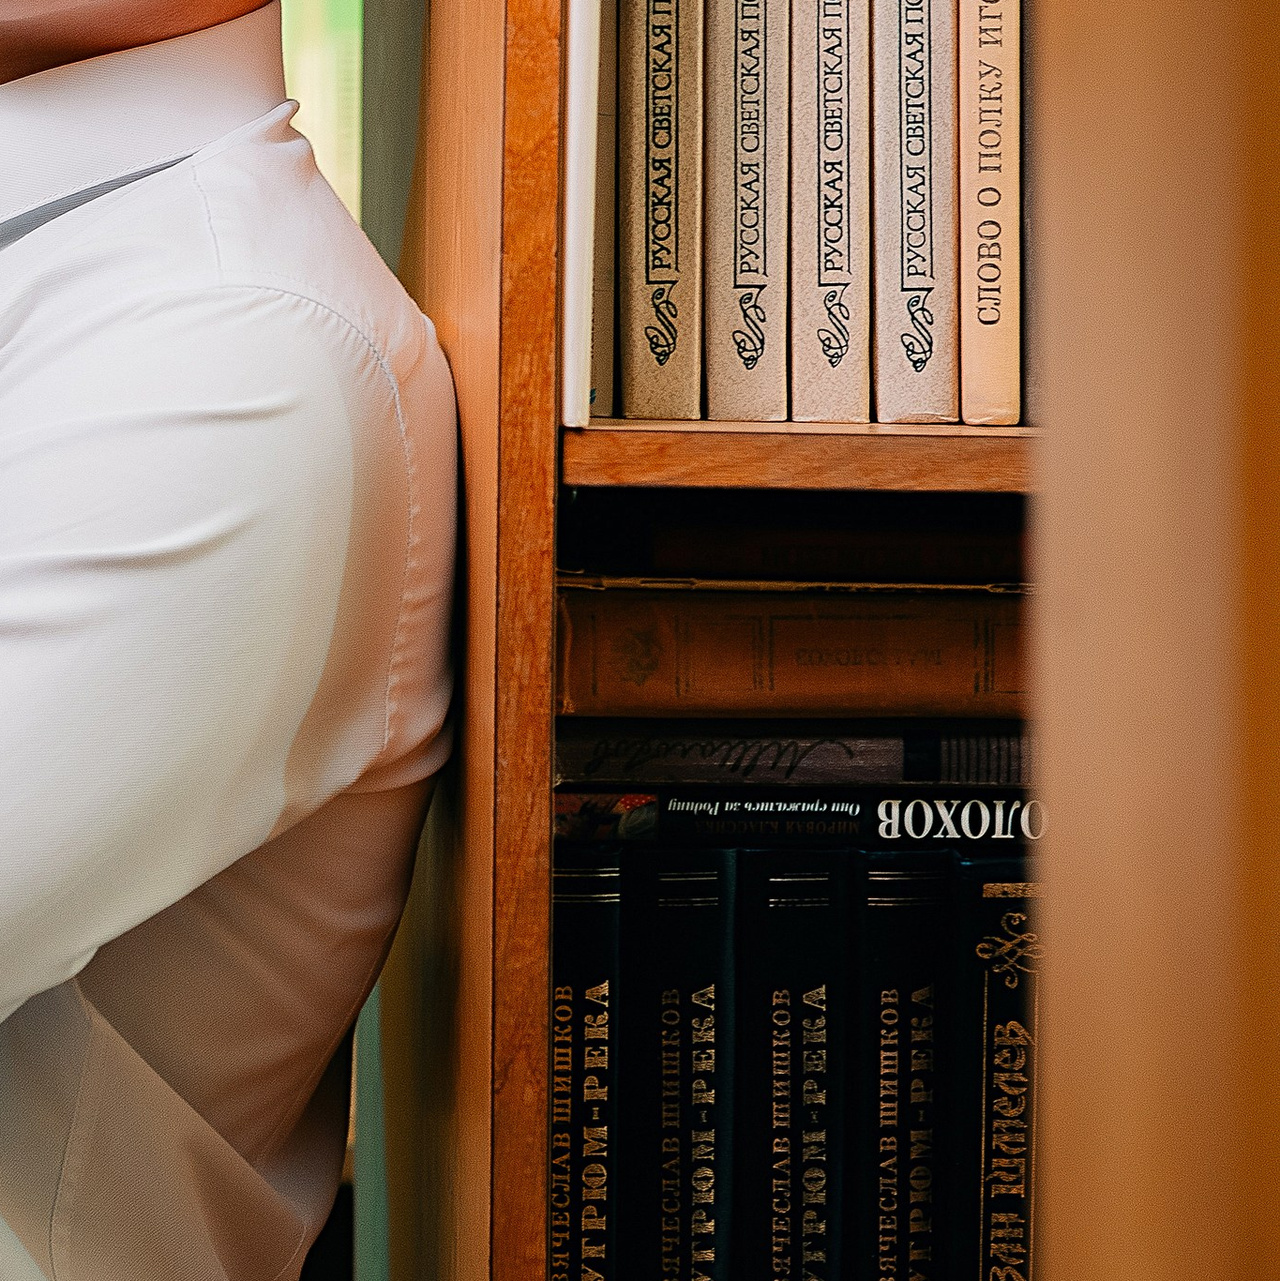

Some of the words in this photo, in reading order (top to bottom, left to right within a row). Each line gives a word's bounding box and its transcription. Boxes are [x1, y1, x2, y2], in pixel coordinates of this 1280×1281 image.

[651, 24, 672, 149] СВЕТСКАЯ
[740, 28, 760, 153] СВЕТСКАЯ
[823, 27, 843, 152] СВЕТСКАЯ
[905, 32, 925, 157] СВЕТСКАЯ
[978, 59, 1002, 174] ПОЛКУ
[651, 156, 672, 270] РУССКАЯ
[739, 162, 760, 275] РУССКАЯ
[823, 160, 843, 272] РУССКАЯ
[906, 165, 926, 278] РУССКАЯ
[976, 186, 1002, 208] О
[976, 220, 1002, 326] СЛОВО
[667, 798, 720, 816] Родину
[724, 800, 741, 812] за
[743, 798, 828, 812] сражались
[785, 819, 861, 833] МИРОВАЯ
[830, 801, 861, 816] Они
[553, 985, 573, 1124] ШИШКОВ
[661, 989, 680, 1129] ШИШКОВ
[772, 989, 791, 1129] ШИШКОВ
[879, 988, 899, 1128] ШИШКОВ
